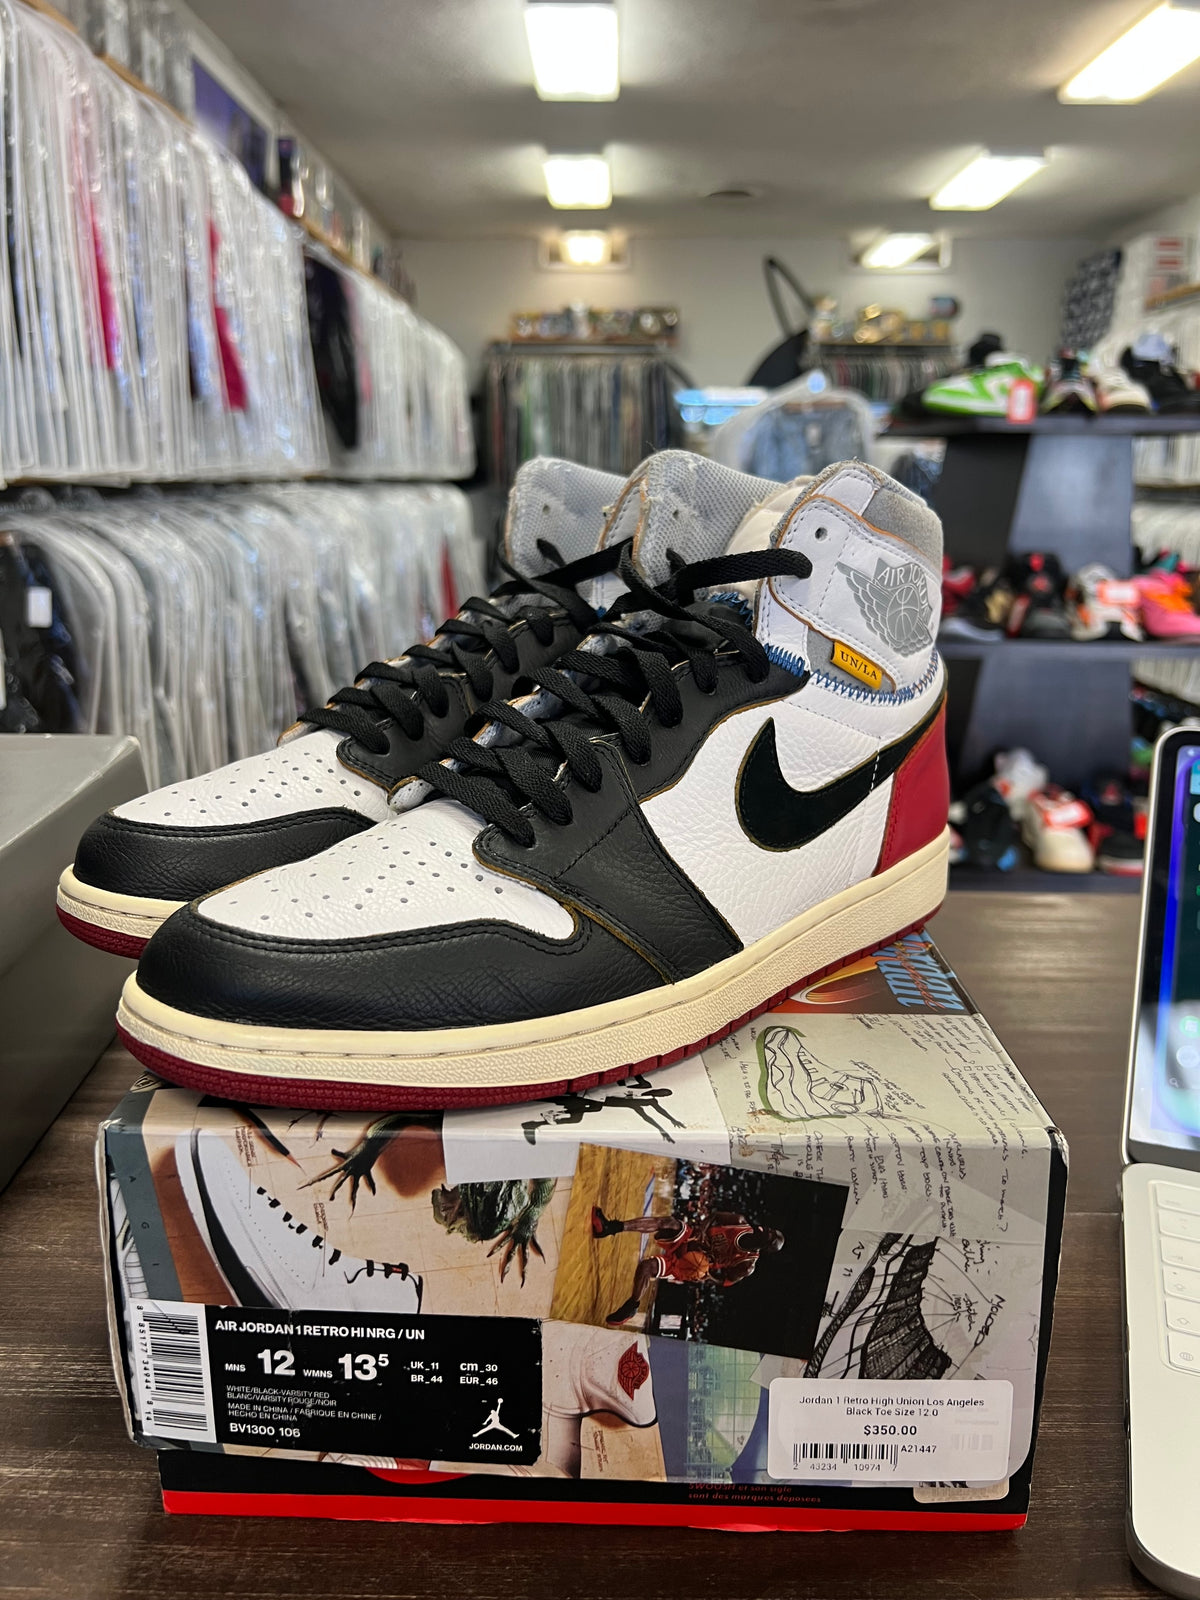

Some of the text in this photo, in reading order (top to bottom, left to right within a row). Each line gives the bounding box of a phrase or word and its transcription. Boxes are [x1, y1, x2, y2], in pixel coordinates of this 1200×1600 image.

[877, 566, 905, 588] AIR
[839, 650, 879, 682] UN/LA
[215, 1319, 425, 1340] AIR JORDAN 1 RETRO HI NRG / UN
[224, 1348, 296, 1376] MNS 12
[303, 1369, 333, 1379] WMNS
[226, 1384, 330, 1399] WHITE/BLACK-VARSITY RED
[226, 1391, 337, 1407] BLANC/VARSITY ROUGE/NOIR
[799, 1395, 985, 1409] Jordan 1 Retro High Union Los Angeles
[227, 1402, 251, 1411] MADE
[252, 1404, 261, 1412] IN
[262, 1405, 289, 1414] CHINA
[294, 1407, 336, 1418] FABRIQUE
[337, 1410, 350, 1419] EN
[351, 1411, 377, 1420] CHINE
[228, 1409, 298, 1421] HECHO EN CHINA
[846, 1406, 939, 1417] Black Toe Size 12.0
[229, 1422, 301, 1438] BV1300 106
[863, 1424, 918, 1437] $350.00
[468, 1442, 523, 1452] JORDAN.COM
[900, 1444, 937, 1454] A21447
[792, 1462, 898, 1472] 2 43234 10974 7
[688, 1492, 709, 1500] sont
[731, 1494, 774, 1503] marques
